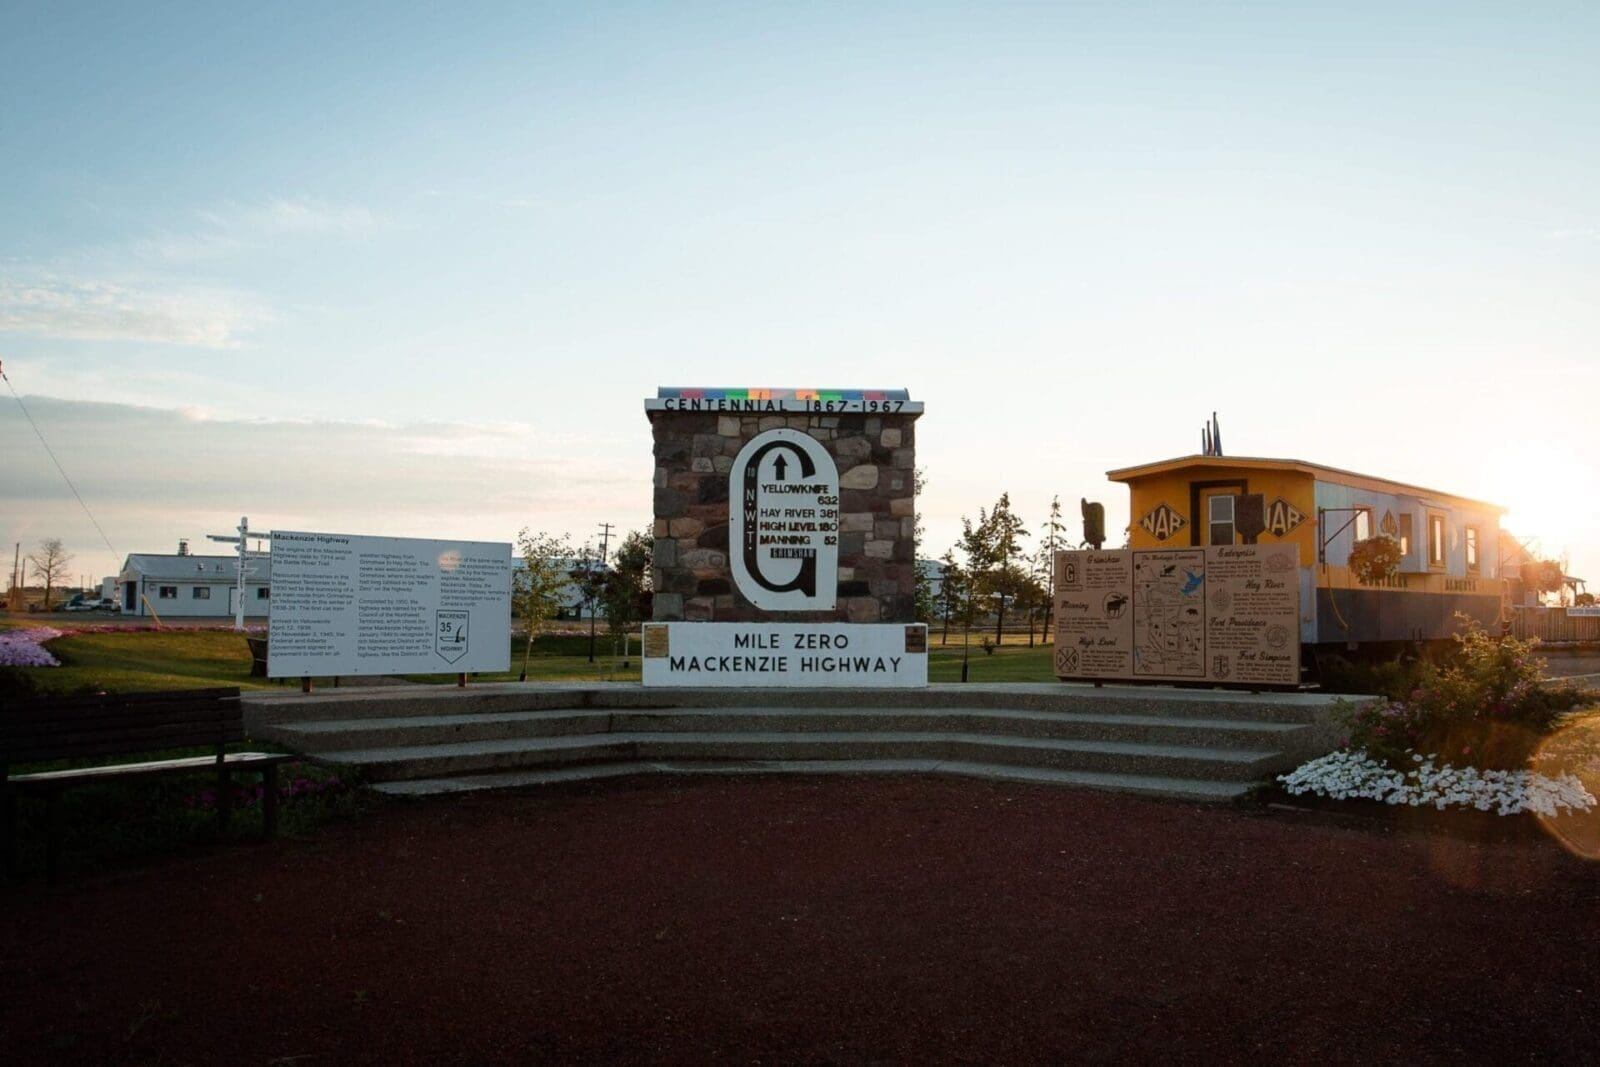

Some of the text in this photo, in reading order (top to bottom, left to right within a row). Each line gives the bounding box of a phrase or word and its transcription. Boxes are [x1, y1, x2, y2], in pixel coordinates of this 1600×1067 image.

[664, 398, 904, 413] CENTENNIAL 1867-1967
[762, 484, 829, 494] YELLOWKNIFE
[818, 496, 838, 504] 632
[761, 509, 838, 518] HAY RIVER 381
[760, 522, 786, 531] HIGH
[789, 522, 817, 532] LEVEL
[1144, 508, 1180, 537] NAR
[317, 536, 350, 544] Highway
[760, 535, 837, 545] MANNING 52
[772, 548, 815, 558] GRIMSHAW
[440, 622, 452, 632] 35
[734, 634, 849, 649] MILE ZERO
[1237, 650, 1291, 662] Fort Simpson
[670, 656, 902, 672] MACKENZIE HIGHWAY
